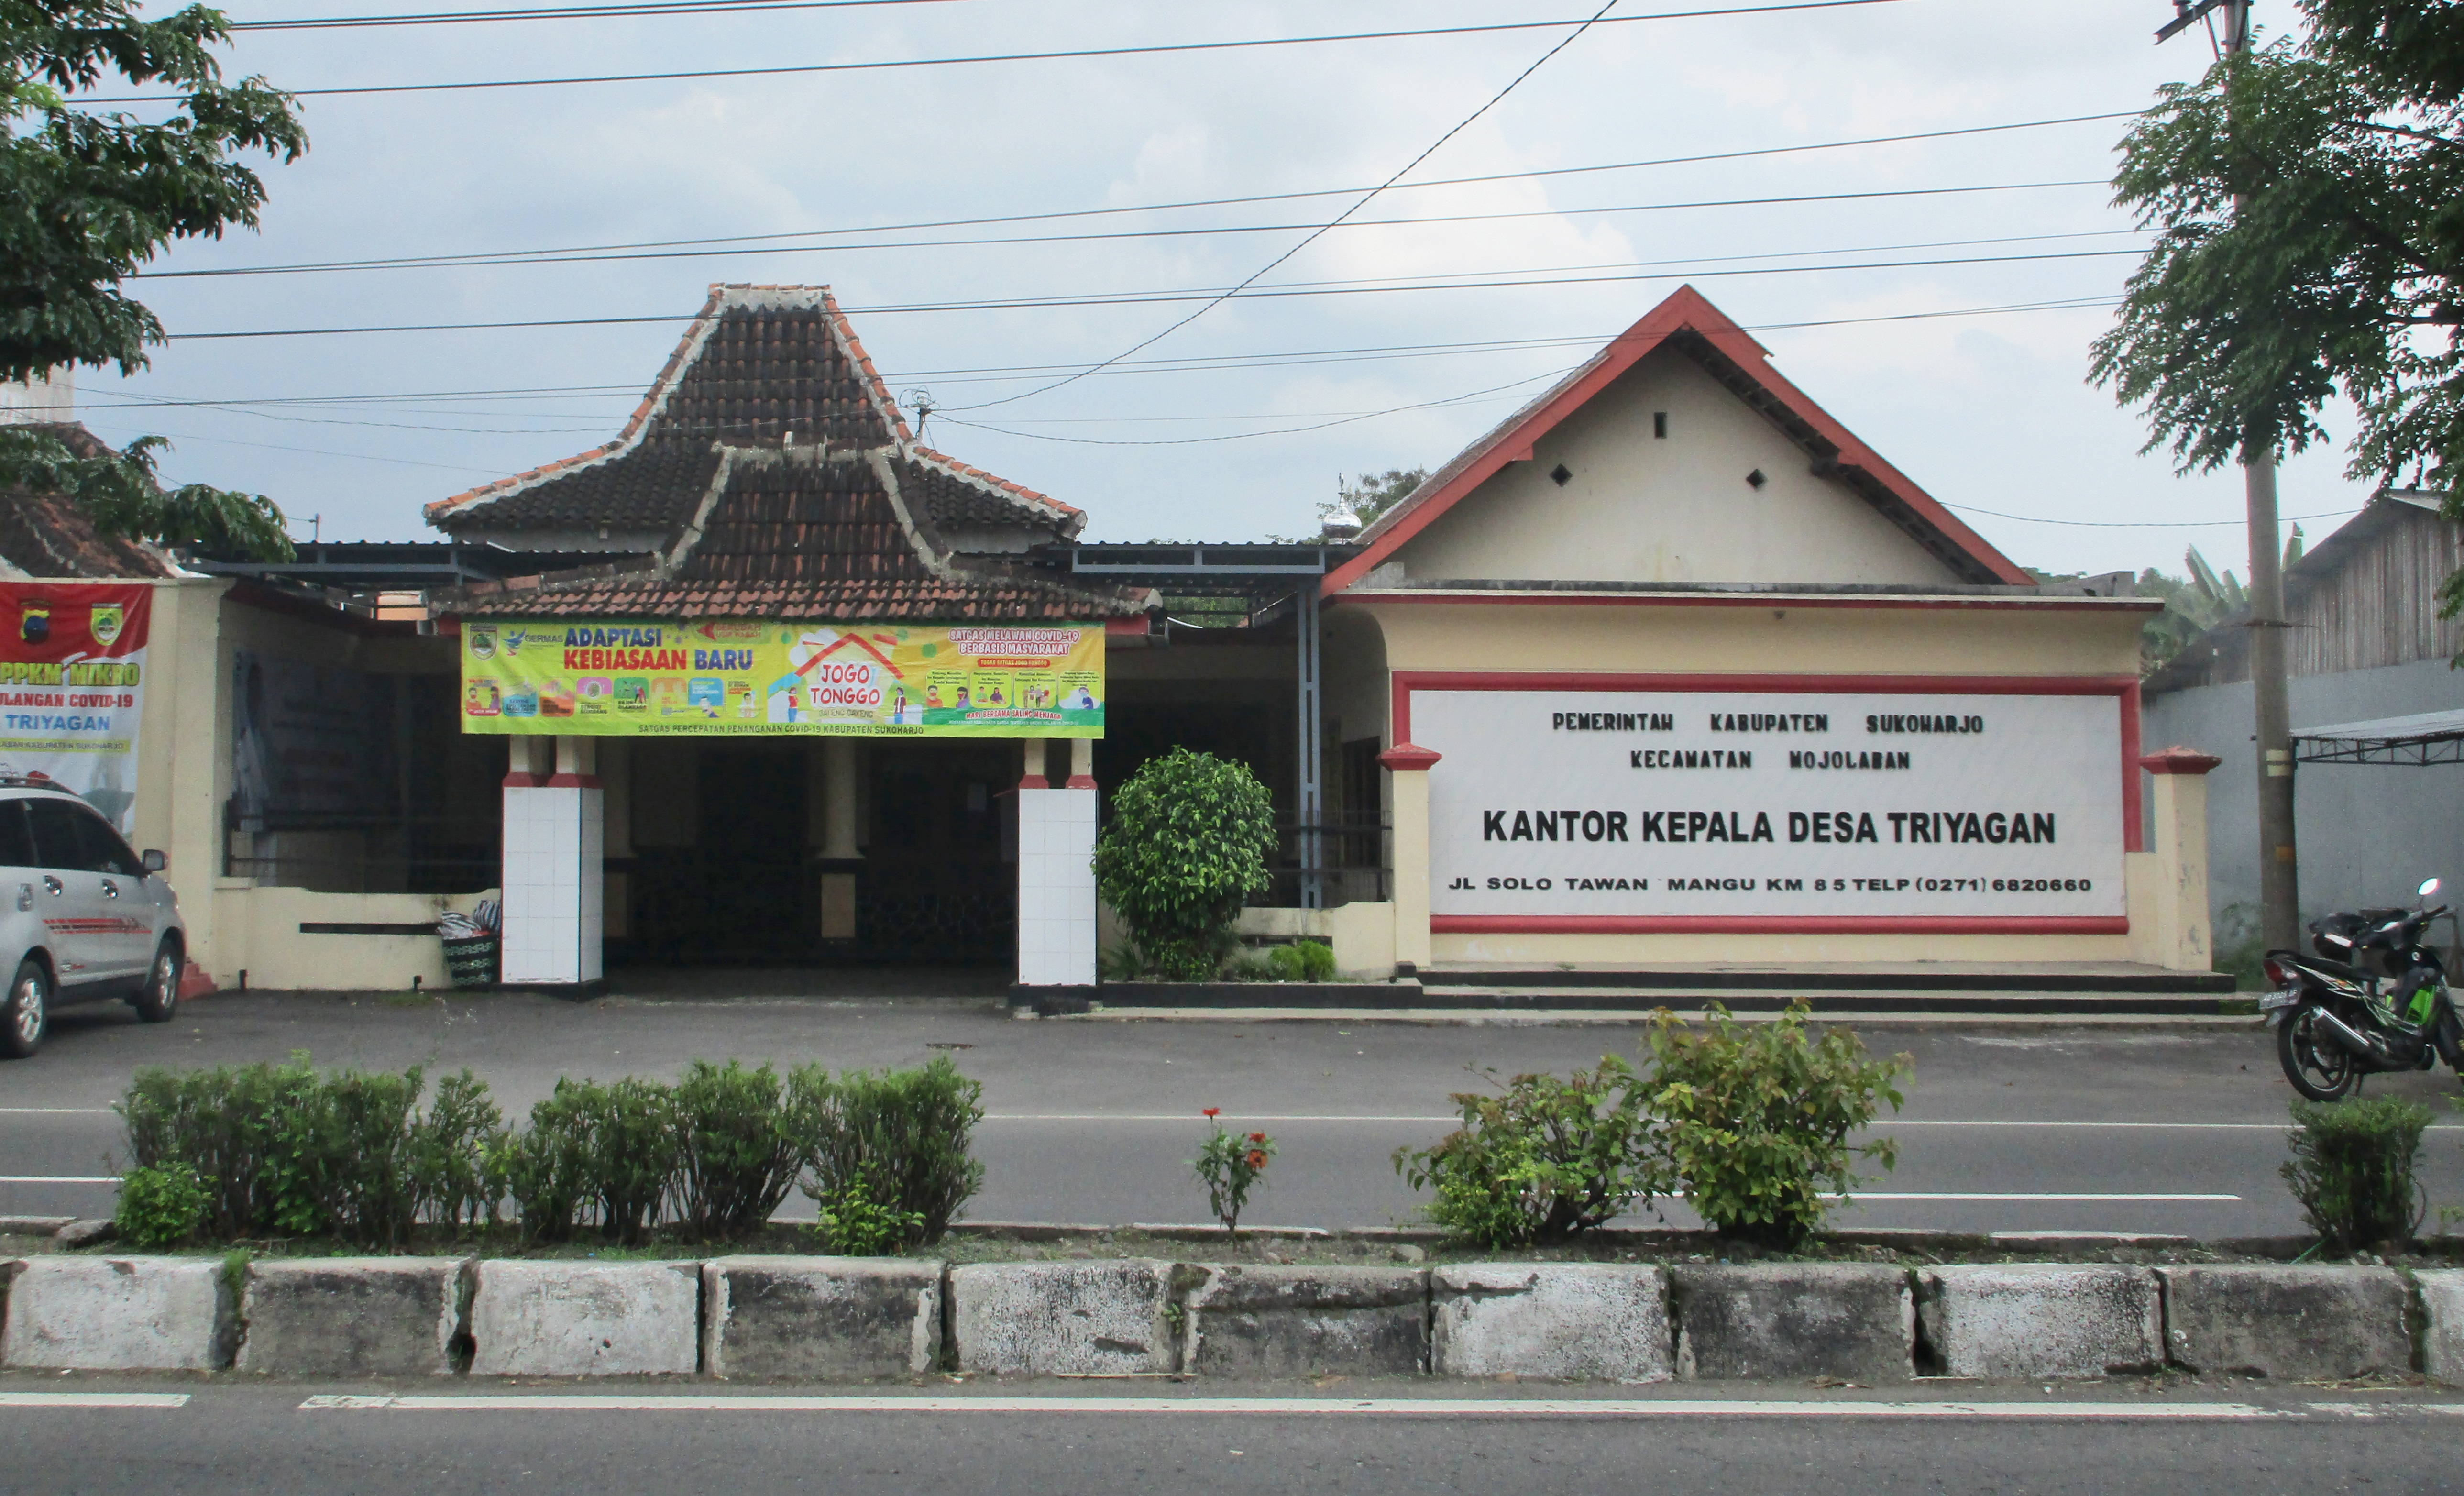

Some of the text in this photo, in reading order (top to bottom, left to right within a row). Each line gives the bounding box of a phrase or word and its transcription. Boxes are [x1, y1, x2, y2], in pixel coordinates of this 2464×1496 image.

[564, 628, 662, 647] ADAPTASI
[950, 629, 1079, 643] SATGAS MELAWAN COVID-19
[960, 643, 1070, 655] BERBASIS MASYARAKAT
[564, 649, 753, 670] KEBIASAAN BARU
[0, 662, 63, 685] PPKM
[821, 664, 869, 684] JOGO
[69, 694, 133, 708] COVID-19
[810, 687, 880, 705] TONGGO
[5, 715, 110, 731] TRIYAGAN
[1034, 711, 1061, 719] MENJAGA
[1552, 712, 1983, 733] PEMERINTAH KABUPATEN SUKOHARJO
[638, 725, 669, 733] SATGAS
[672, 725, 725, 733] PERCEPATAN
[728, 725, 782, 733] PENANGANAN
[824, 725, 872, 734] KABUPATEN
[875, 726, 924, 734] SUKOHARJO
[1631, 750, 1910, 769] KECAMATAN MOJOLABAN
[1483, 810, 2055, 843] KANTOR KEPALA DESA TRIYAGAN
[1449, 878, 1475, 890] JL
[1487, 877, 1552, 890] SOLO
[1564, 878, 1648, 891] TAWAN
[1667, 878, 1756, 891] MANGU
[1766, 879, 1803, 891] KM
[1852, 879, 1910, 891] TELP
[1916, 877, 1987, 892] (0271)
[1992, 879, 2092, 891] 6820660
